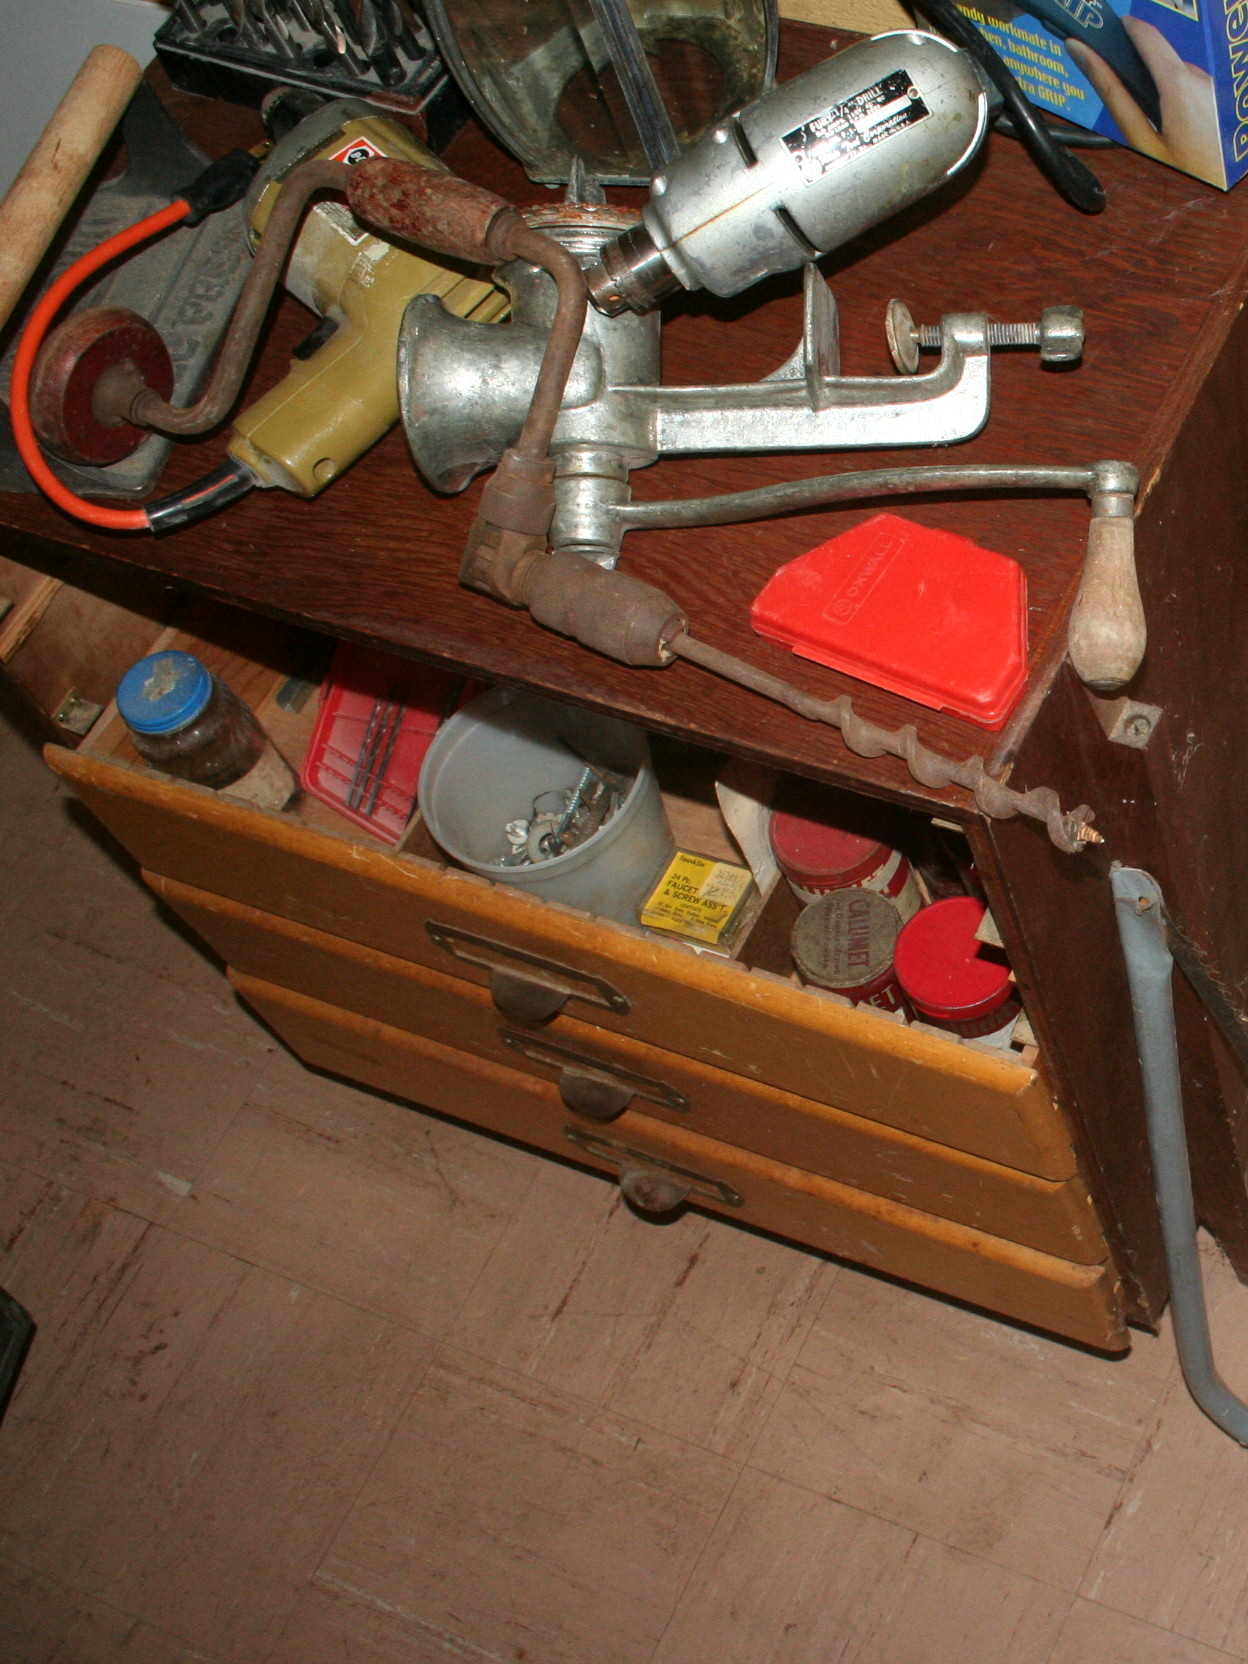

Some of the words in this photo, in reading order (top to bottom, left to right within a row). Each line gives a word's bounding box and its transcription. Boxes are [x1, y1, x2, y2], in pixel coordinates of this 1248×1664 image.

[987, 15, 1047, 49] workmate
[1050, 40, 1062, 56] in
[1003, 56, 1060, 89] anywhere
[1062, 82, 1086, 100] you
[856, 87, 883, 106] DRILL
[663, 888, 671, 896] &
[671, 890, 700, 904] SCREW
[667, 880, 699, 895] FAUCET
[847, 900, 870, 967] CALUMET
